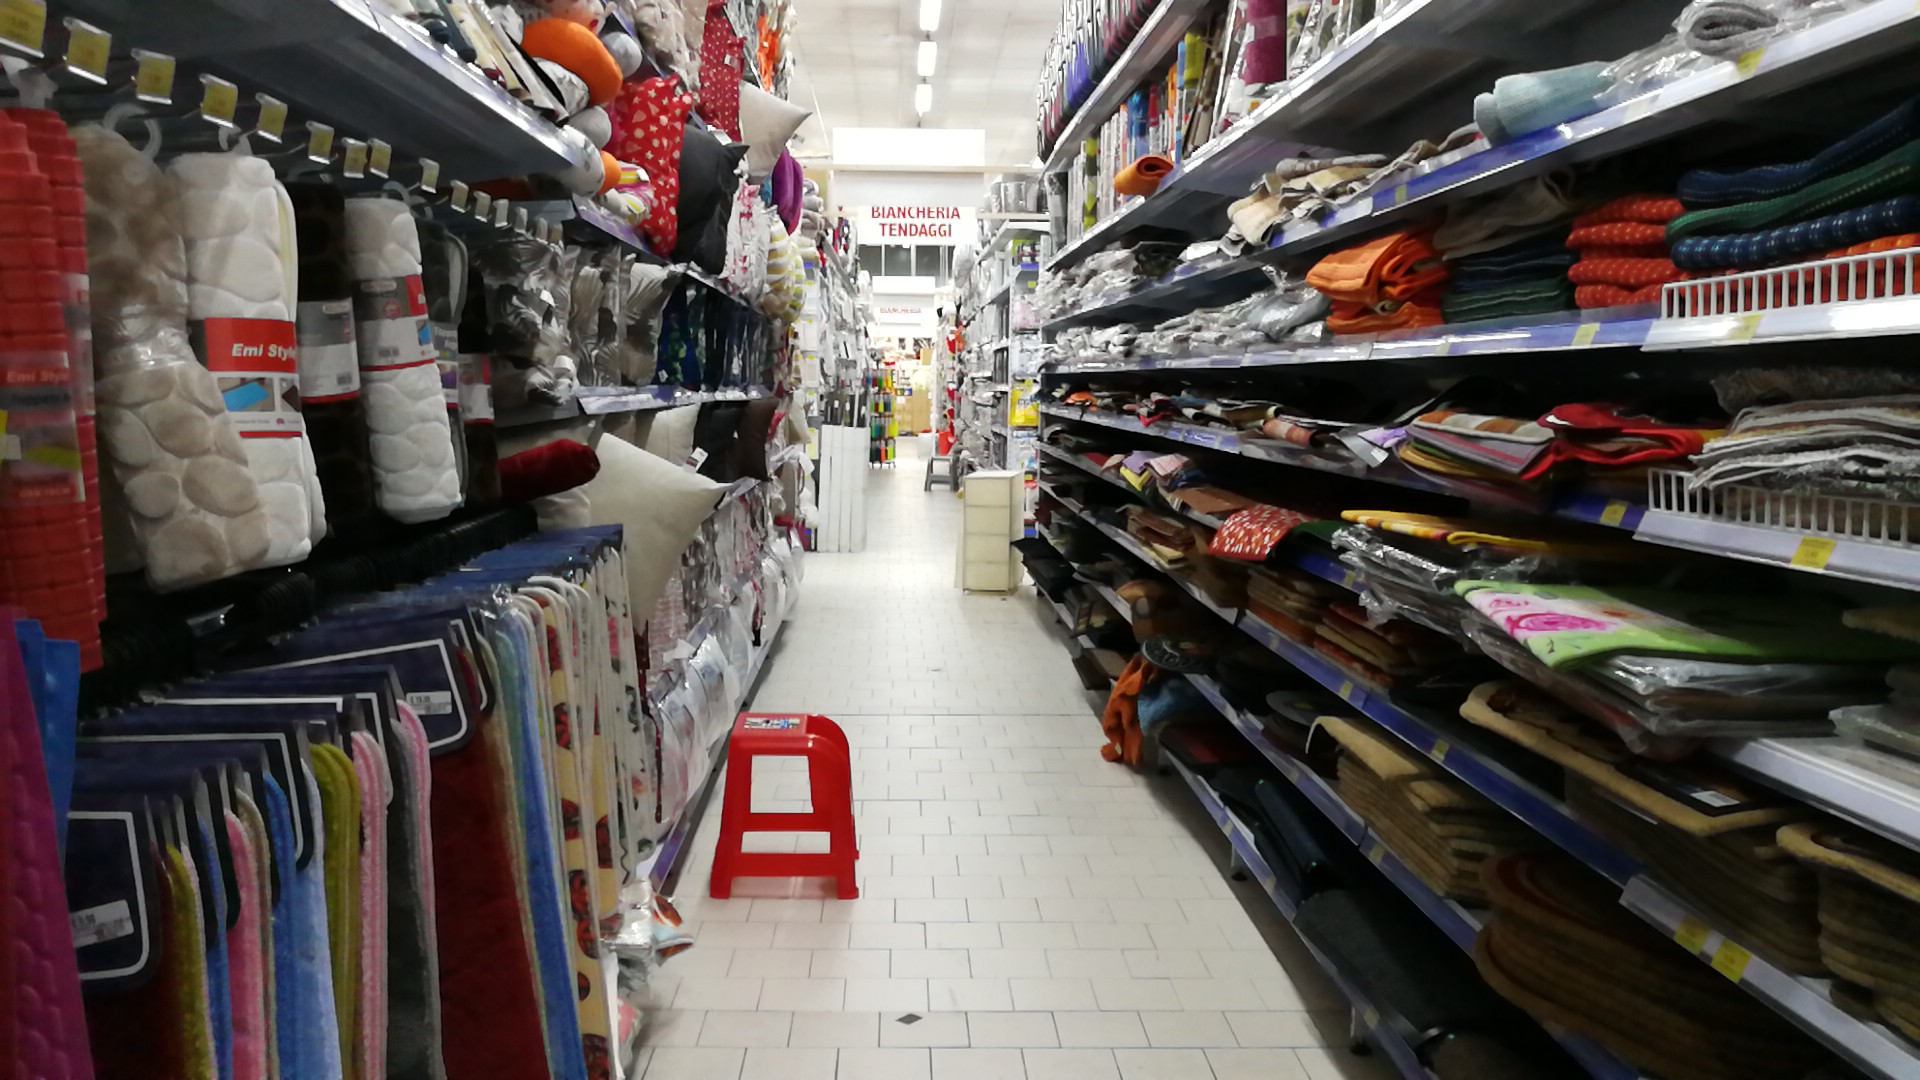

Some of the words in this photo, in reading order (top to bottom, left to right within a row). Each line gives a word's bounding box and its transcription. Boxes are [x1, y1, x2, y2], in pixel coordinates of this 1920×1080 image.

[872, 206, 961, 219] BIANCHERIA
[879, 223, 952, 237] TENDAGGI
[231, 343, 263, 357] Emi
[7, 370, 35, 383] Emi
